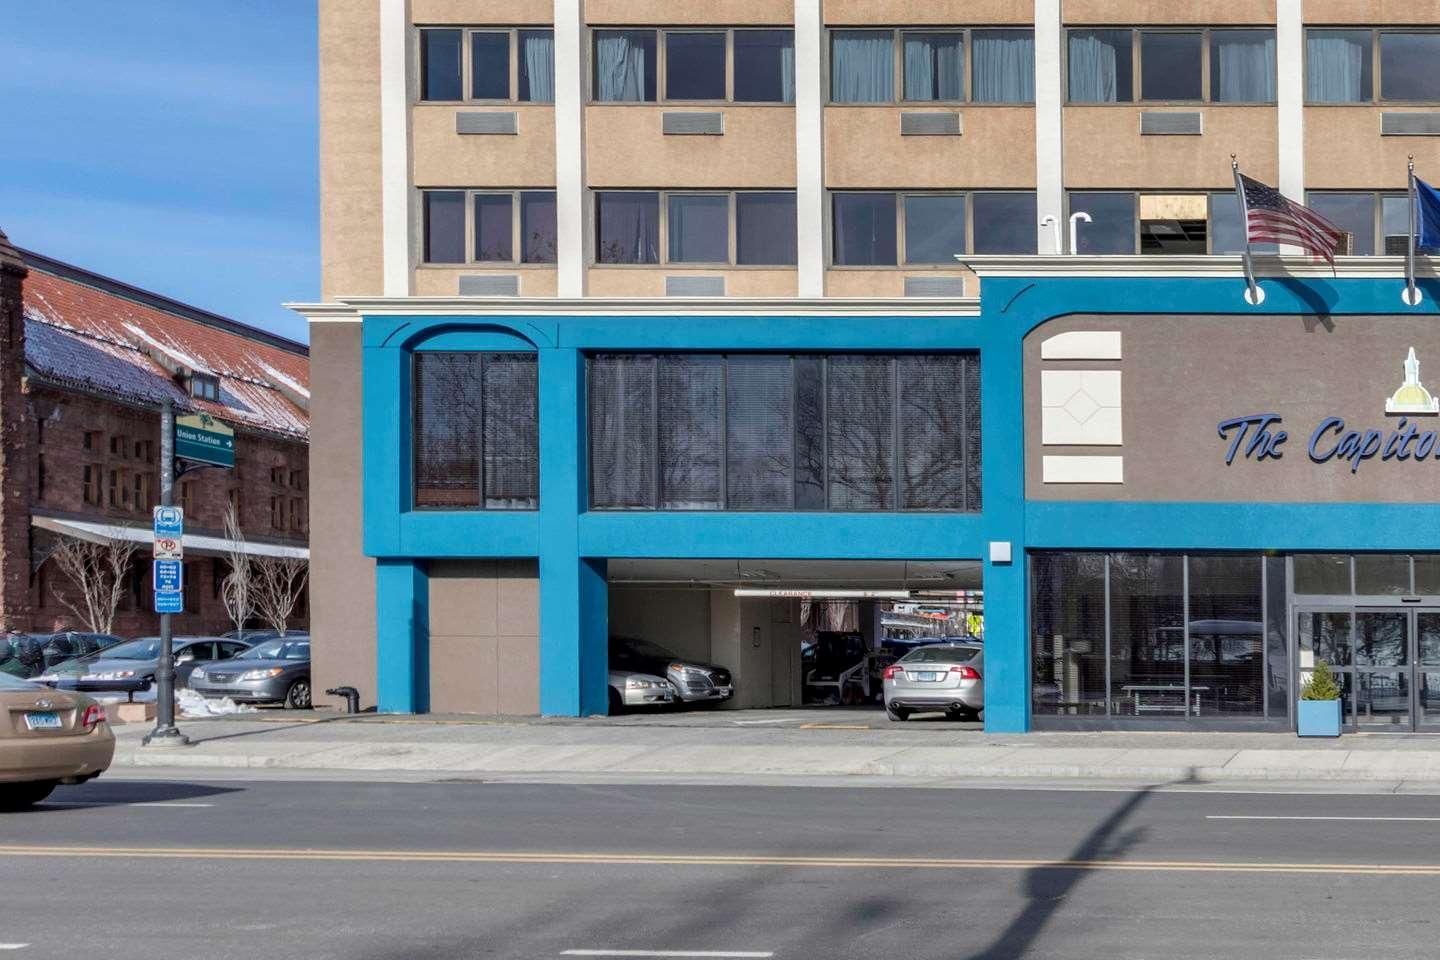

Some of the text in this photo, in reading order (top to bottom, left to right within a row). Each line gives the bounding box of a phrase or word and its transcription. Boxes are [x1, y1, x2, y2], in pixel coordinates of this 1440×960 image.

[177, 429, 220, 445] Union Station
[1218, 413, 1289, 466] The
